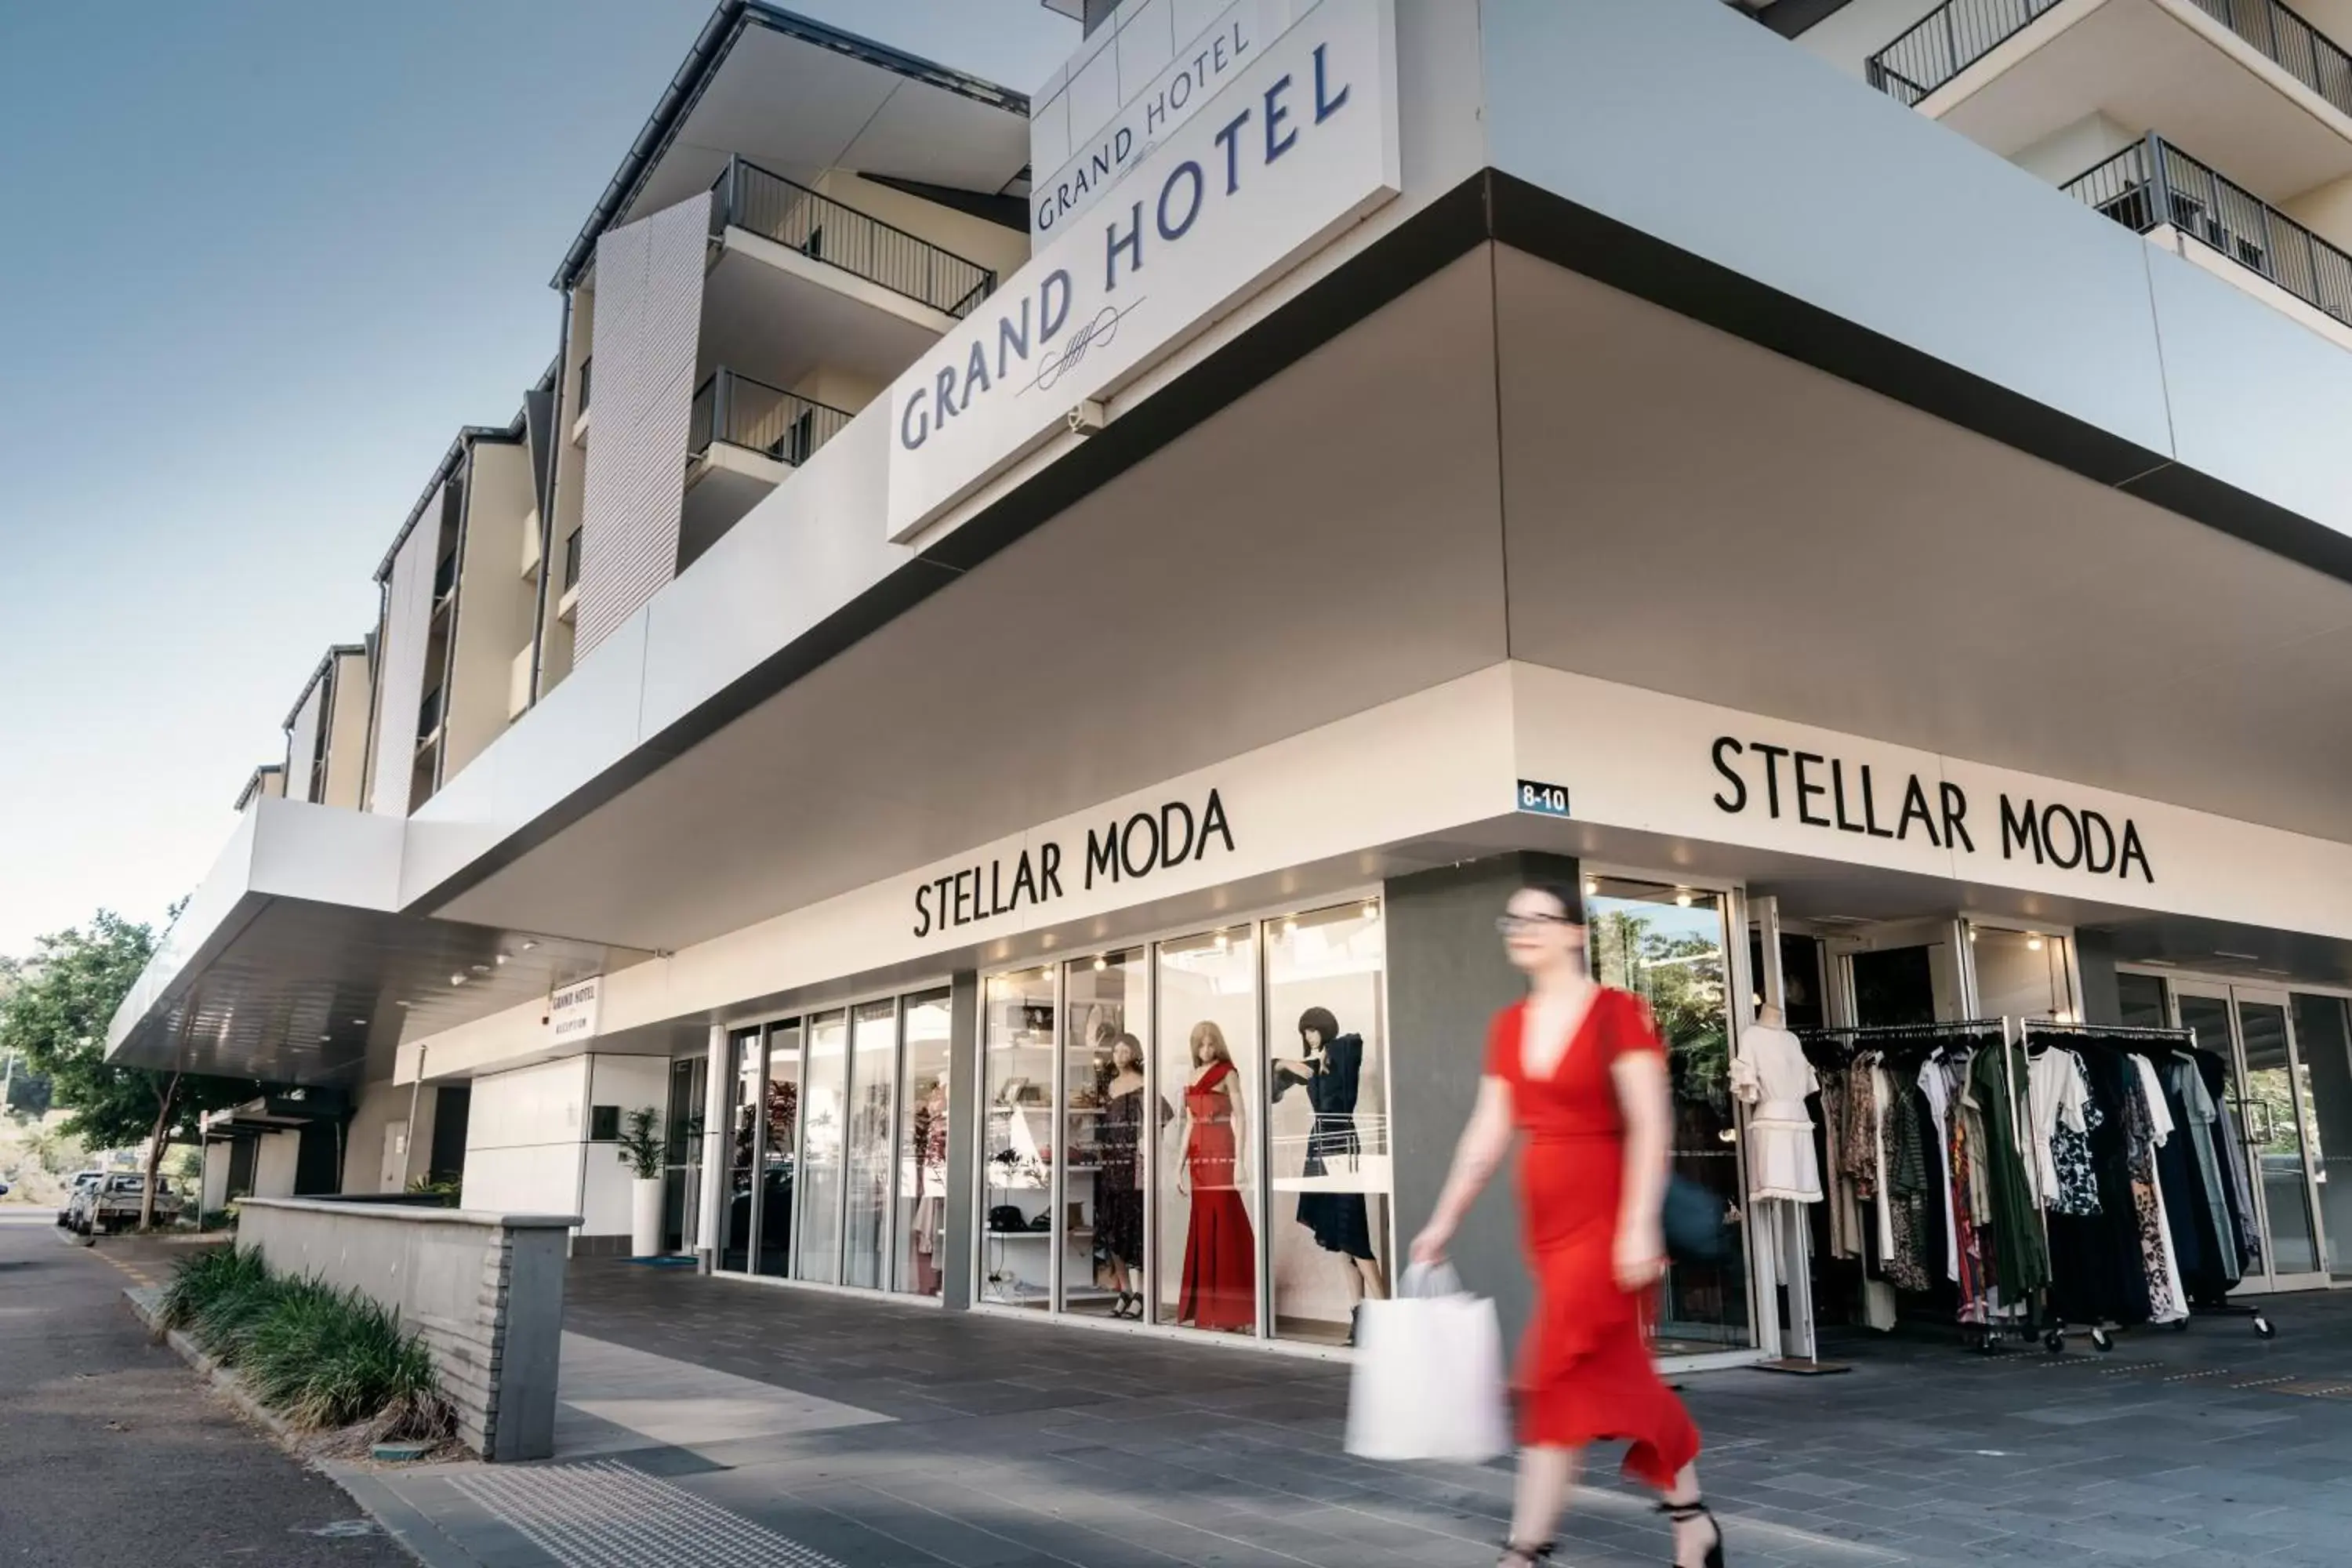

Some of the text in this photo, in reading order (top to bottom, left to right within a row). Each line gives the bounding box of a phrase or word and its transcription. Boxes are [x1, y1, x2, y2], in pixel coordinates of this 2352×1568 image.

[1037, 21, 1250, 232] GRAND HOTEL
[901, 42, 1351, 451] GRAND HOTEL
[913, 788, 1236, 938] STELLAR MODA
[1523, 785, 1565, 811] 8-10
[1711, 735, 2155, 884] STELLAR MODA
